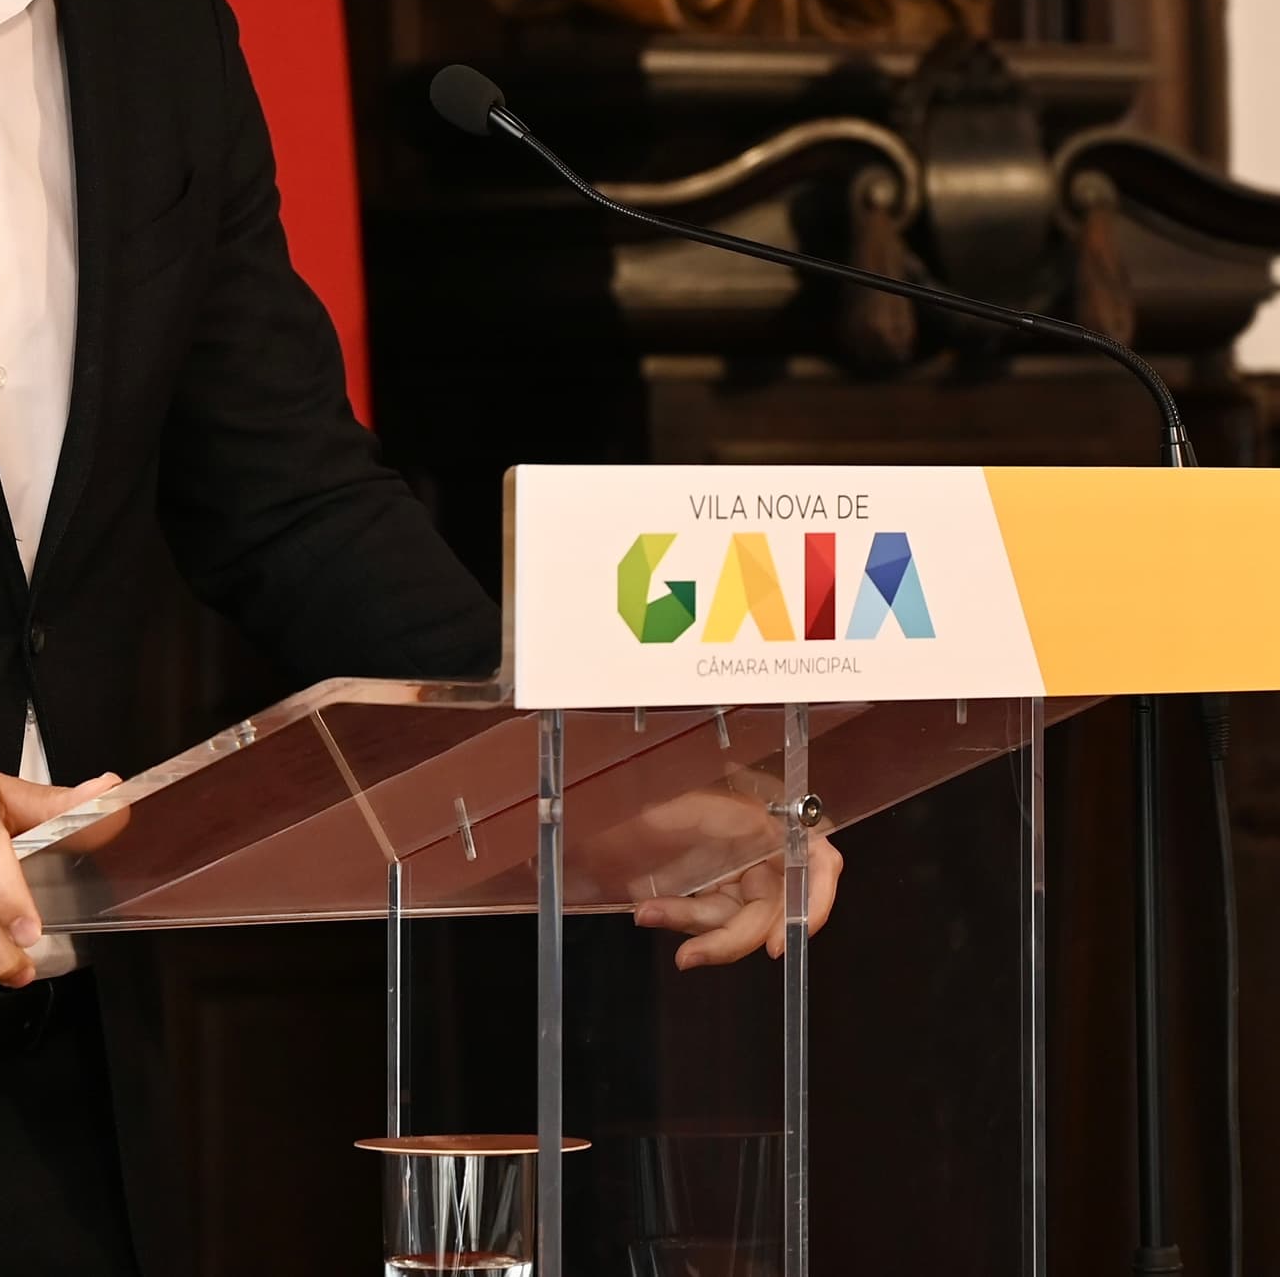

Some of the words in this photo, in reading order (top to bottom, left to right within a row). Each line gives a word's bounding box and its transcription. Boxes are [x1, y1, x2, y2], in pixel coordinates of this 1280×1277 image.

[689, 494, 748, 520] VILA
[757, 494, 828, 520] NOVA
[837, 494, 870, 520] DE
[616, 531, 936, 644] GAIA
[696, 654, 769, 677] CÂMARA
[774, 656, 862, 676] MUNICIPAL
